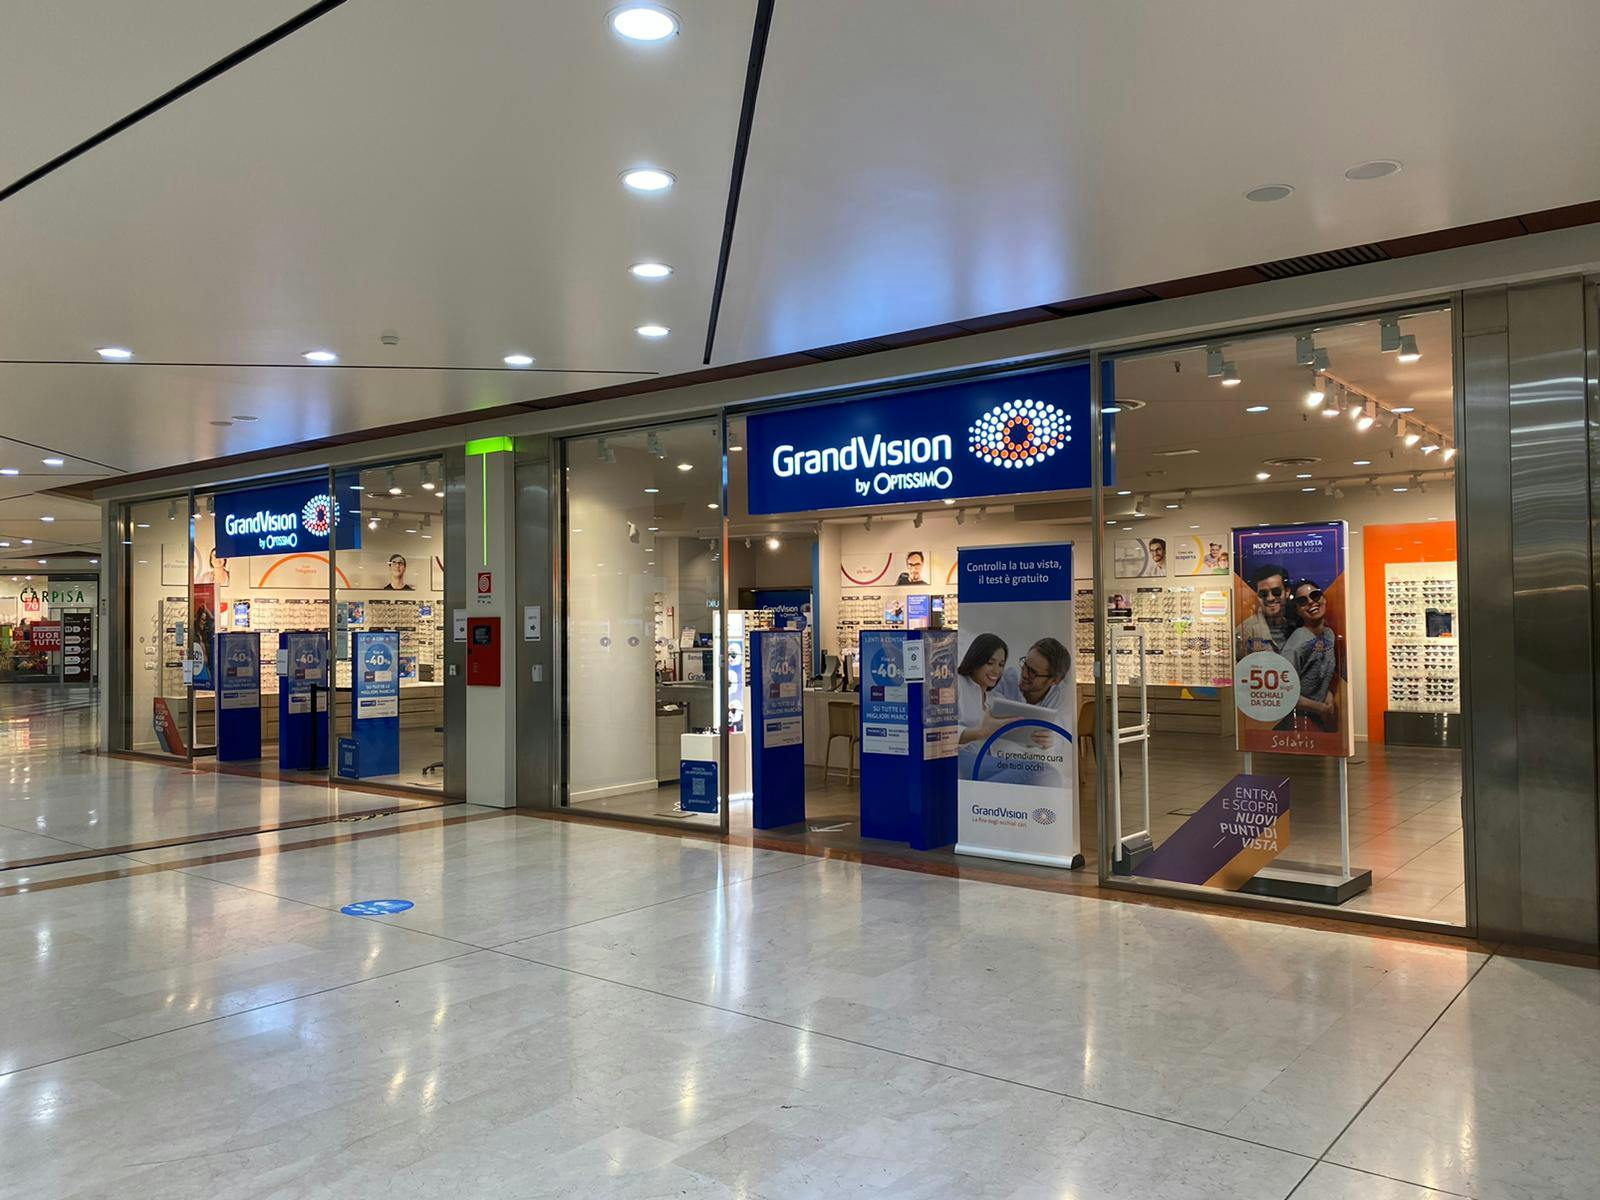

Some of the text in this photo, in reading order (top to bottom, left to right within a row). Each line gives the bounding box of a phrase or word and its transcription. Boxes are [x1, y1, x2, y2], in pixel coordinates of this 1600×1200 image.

[772, 434, 952, 477] GrandVision
[855, 467, 953, 496] by OPTISSIMO
[225, 510, 297, 535] GrandVision
[1274, 541, 1294, 549] PUNTI
[1303, 539, 1323, 547] VISTA
[966, 559, 1062, 572] Controlla la tua vista,
[978, 573, 1049, 586] il test è gratuito
[20, 590, 84, 602] CARPISA
[1250, 691, 1284, 699] OCCHIALI
[1271, 735, 1314, 749] Solaris
[996, 750, 1064, 763] Ci prendiamo cura
[1009, 762, 1024, 770] tuoi
[1025, 762, 1044, 771] occhi
[1235, 787, 1278, 801] ENTRA
[972, 805, 1028, 820] GrandVision
[1222, 798, 1278, 814] E SCOPRI
[1235, 812, 1277, 826] NUOVI
[1219, 822, 1278, 840] PUNTI DI
[1242, 837, 1278, 852] VISTA
